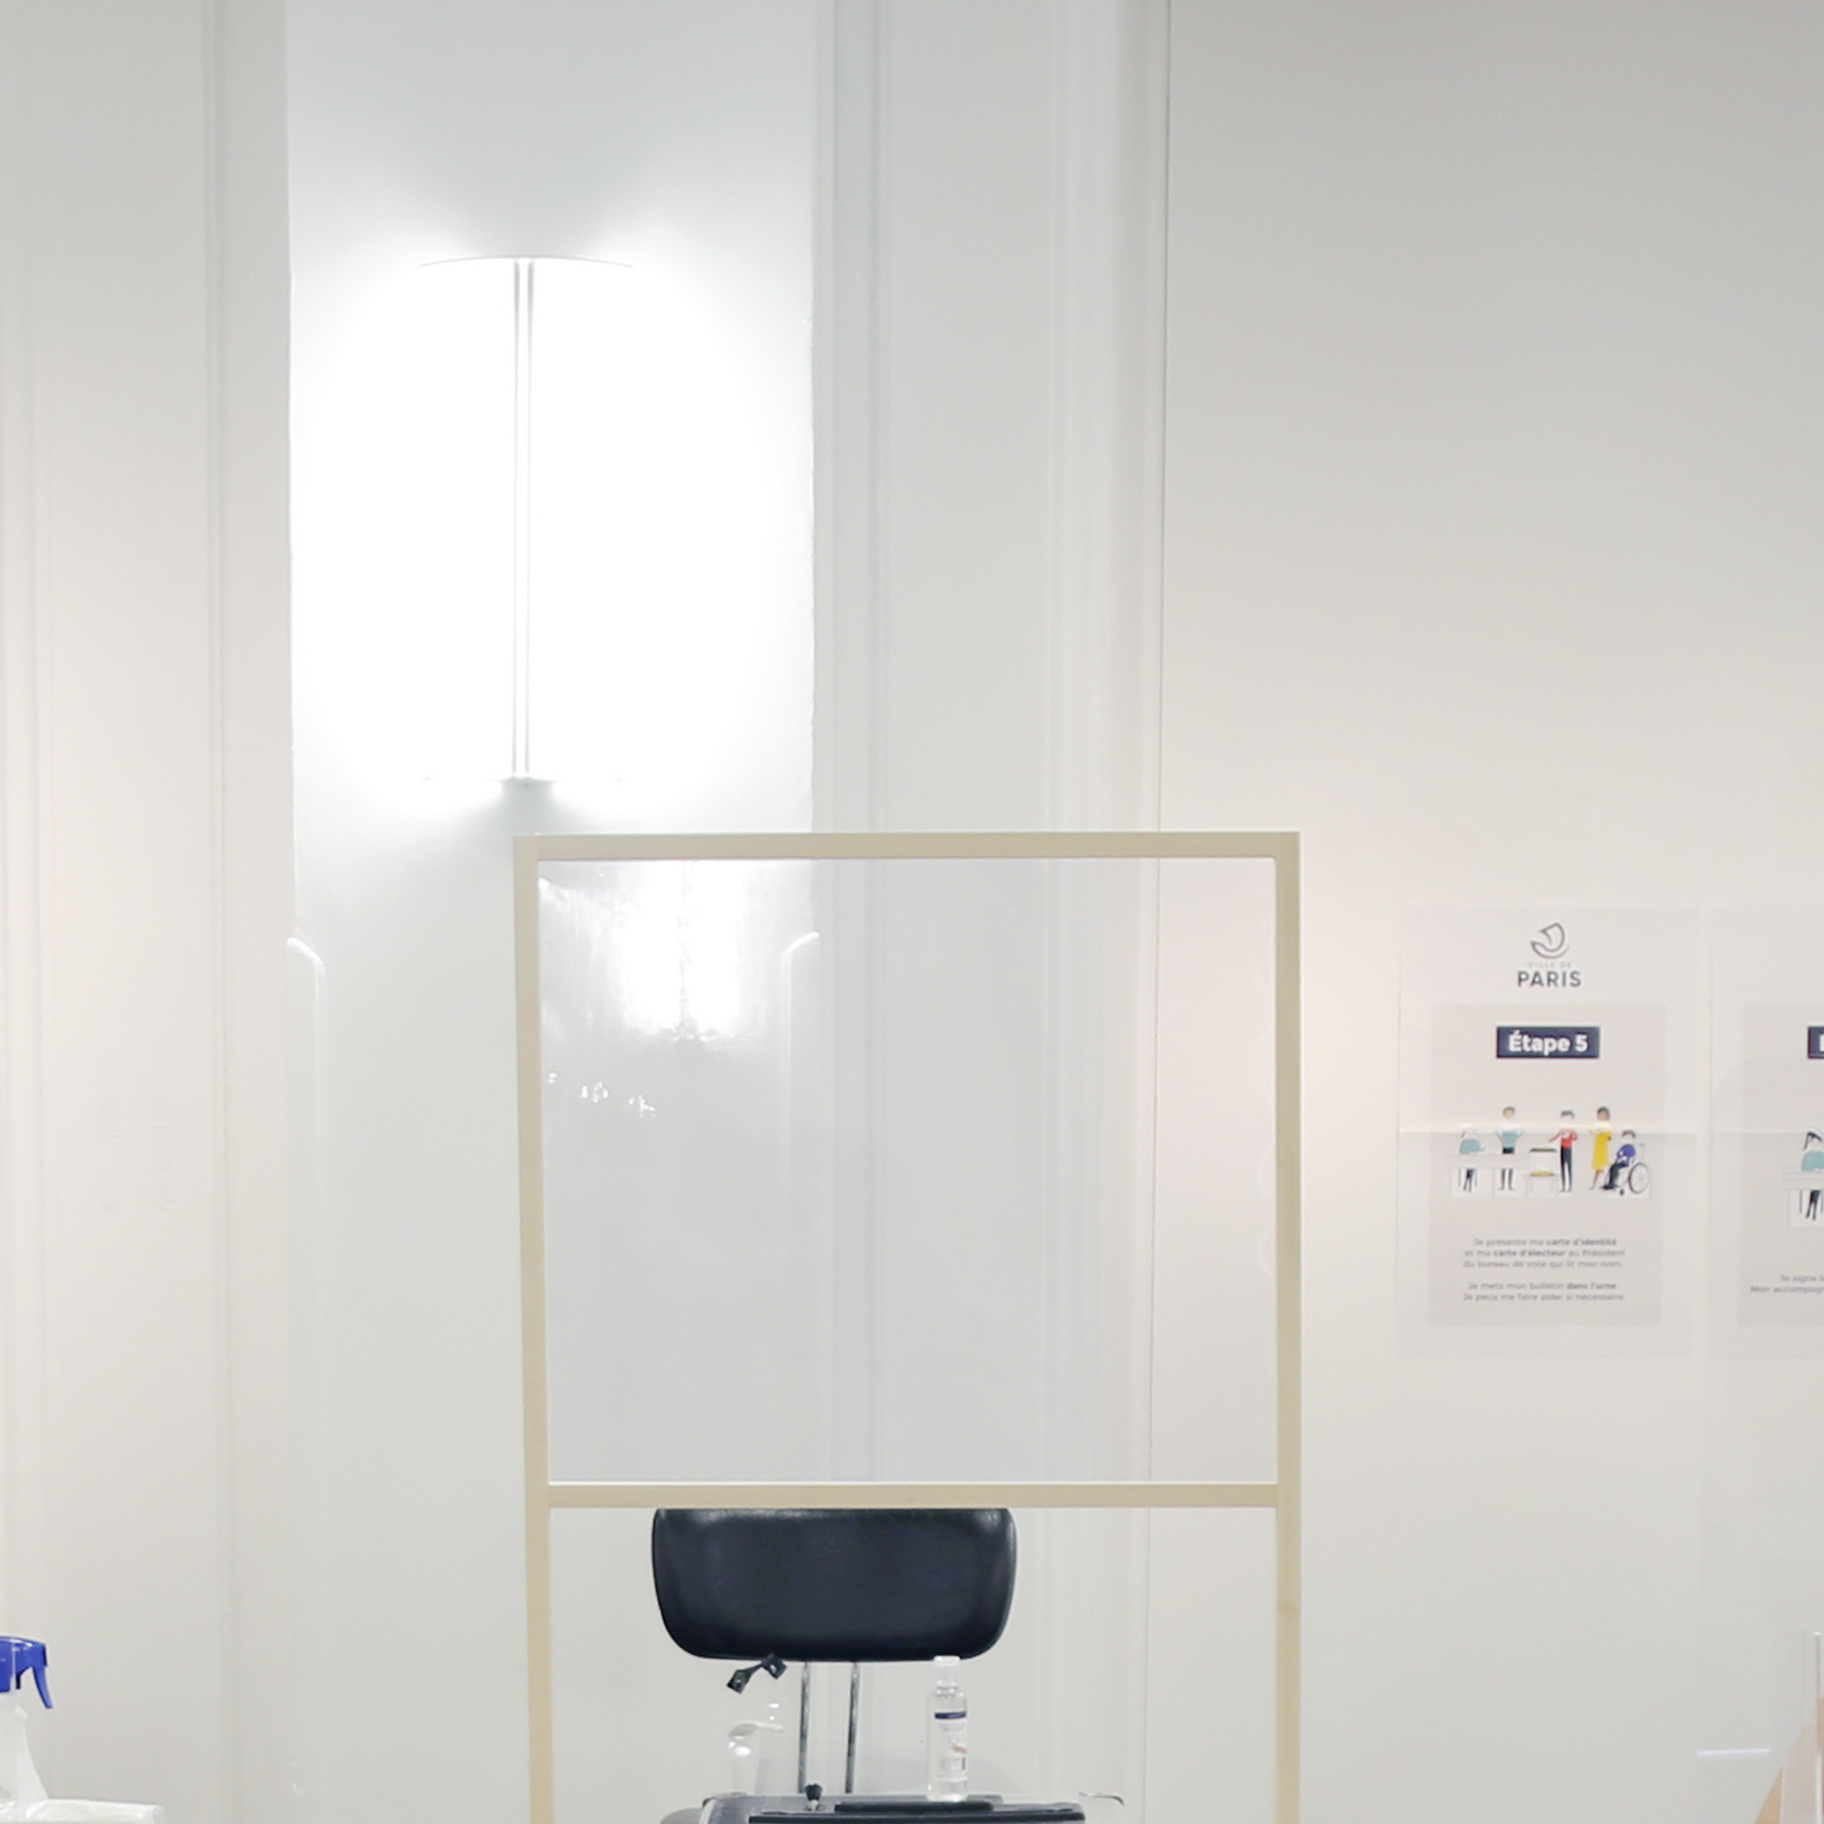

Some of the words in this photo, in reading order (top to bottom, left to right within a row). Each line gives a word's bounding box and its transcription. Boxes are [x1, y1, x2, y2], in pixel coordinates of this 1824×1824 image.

[1518, 971, 1581, 987] PARIS
[1508, 1030, 1571, 1056] Étape
[1576, 1035, 1588, 1052] 5
[1486, 1238, 1526, 1247] présente
[1547, 1238, 1570, 1247] carte
[1573, 1238, 1616, 1247] d'identité
[1493, 1249, 1516, 1257] carte
[1520, 1249, 1566, 1257] d'électeur
[1582, 1249, 1625, 1257] Président
[1478, 1260, 1510, 1269] bureau
[1530, 1282, 1564, 1290] bulletin
[1567, 1282, 1588, 1290] dans
[1518, 1293, 1537, 1301] faire
